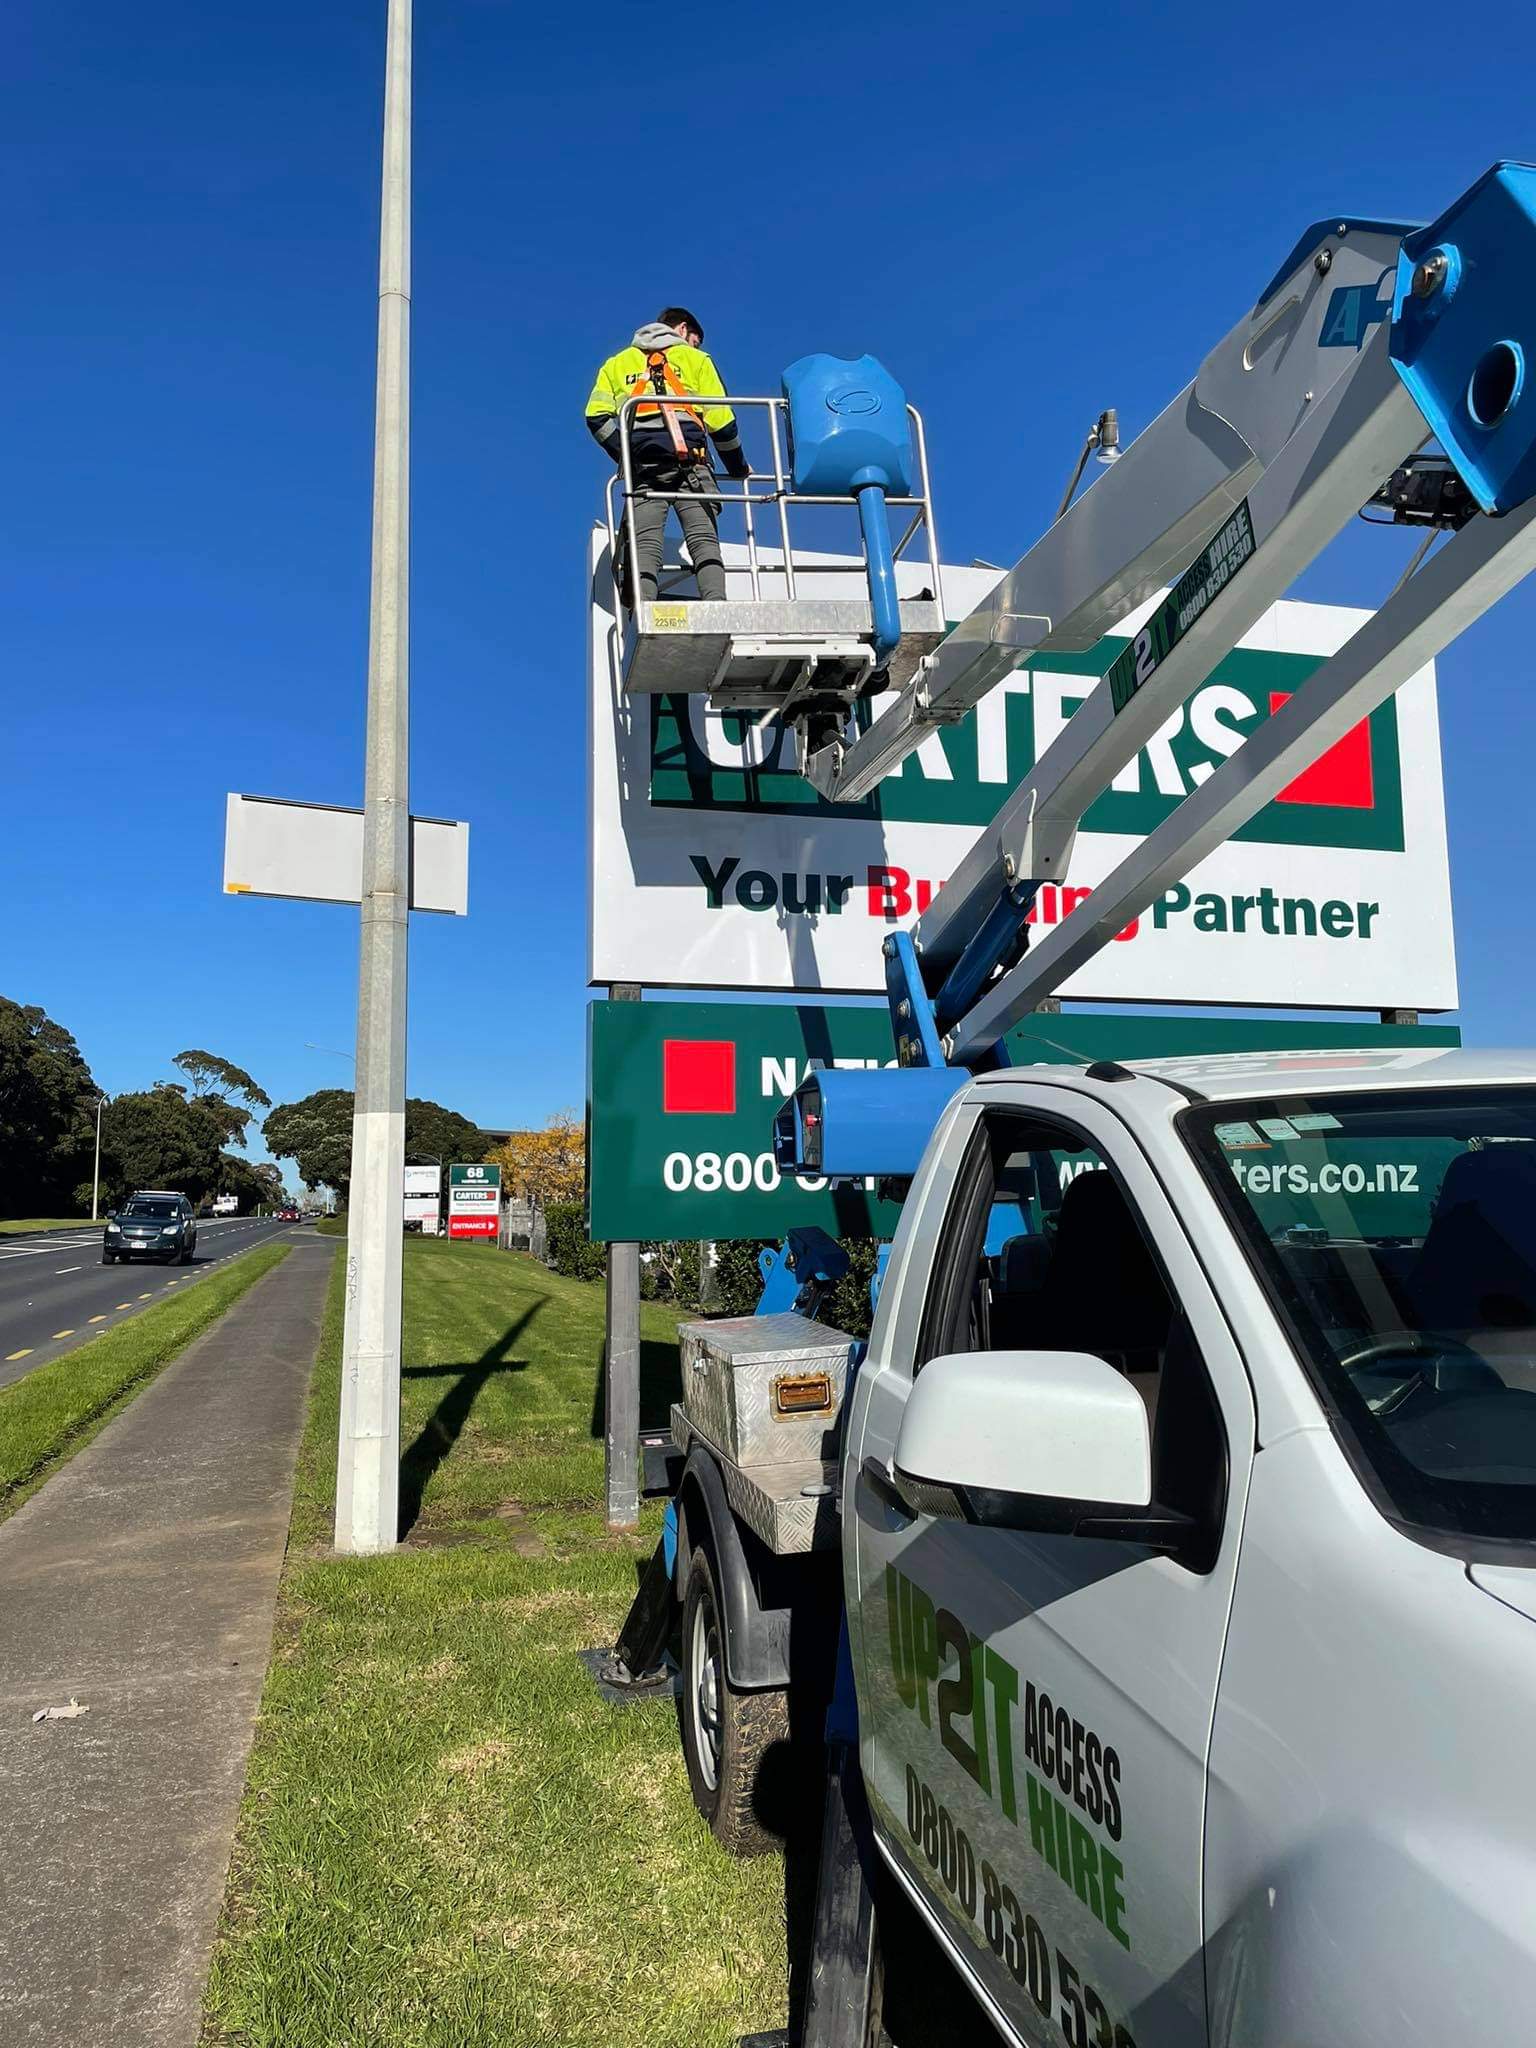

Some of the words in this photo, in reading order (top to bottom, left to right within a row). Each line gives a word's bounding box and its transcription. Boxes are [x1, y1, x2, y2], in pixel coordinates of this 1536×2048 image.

[1209, 507, 1249, 570] HIRE
[1179, 588, 1207, 631] 0800
[1206, 561, 1229, 599] 830
[1228, 533, 1252, 572] 530
[688, 855, 854, 914] Your
[1153, 882, 1380, 939] Partner
[455, 1191, 488, 1200] CARTERS
[467, 1167, 484, 1178] 68
[663, 1152, 782, 1192] 0800
[452, 1222, 487, 1230] ENTRANCE
[1025, 1680, 1122, 1842] ACCESS
[1026, 1772, 1131, 1952] HIRE
[906, 1763, 977, 1921] 0800
[982, 1860, 1052, 2020] 830
[1055, 1946, 1137, 2048] 53
